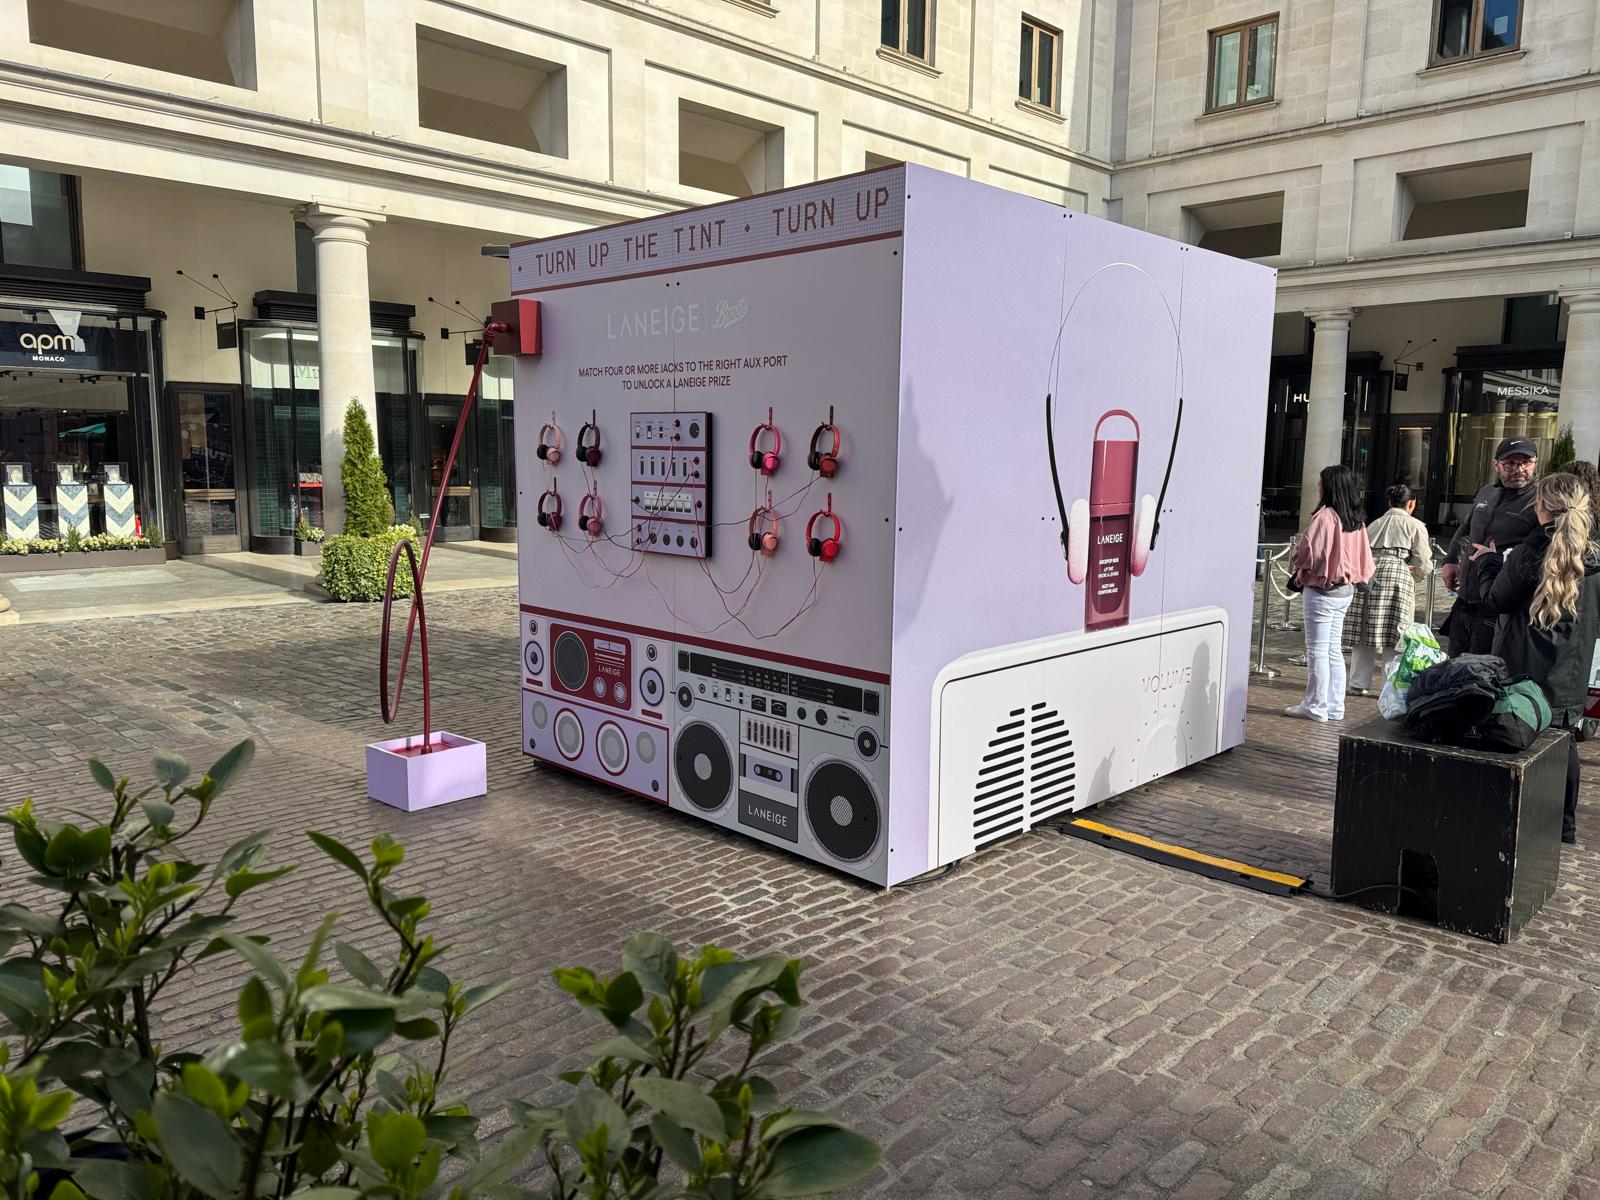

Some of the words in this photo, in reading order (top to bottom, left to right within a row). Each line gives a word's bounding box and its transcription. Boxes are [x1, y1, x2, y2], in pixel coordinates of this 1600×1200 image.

[536, 248, 576, 276] TURN
[588, 242, 609, 268] UP
[624, 233, 658, 262] THE
[674, 219, 726, 253] TINT
[773, 197, 835, 235] TURN
[856, 186, 889, 221] UP
[607, 304, 700, 339] LANEIGE
[20, 333, 75, 355] apm
[578, 367, 603, 377] MATCH
[604, 365, 624, 376] FOUR
[625, 365, 636, 375] OR
[637, 363, 659, 374] MORE
[660, 362, 684, 373] JACKS
[685, 361, 697, 372] TO
[698, 360, 714, 371] THE
[715, 358, 742, 370] RIGHT
[743, 357, 761, 369] AUX
[763, 355, 788, 367] PORT
[622, 380, 632, 390] TO
[633, 378, 665, 390] UNLOCK
[666, 378, 672, 388] A
[673, 376, 707, 388] LANEIGE
[708, 375, 731, 387] PRIZE
[1497, 386, 1549, 396] MESSIKA
[1097, 533, 1124, 545] LANEIGE
[598, 664, 621, 677] LANEIGE
[748, 804, 788, 827] LANEIGE
